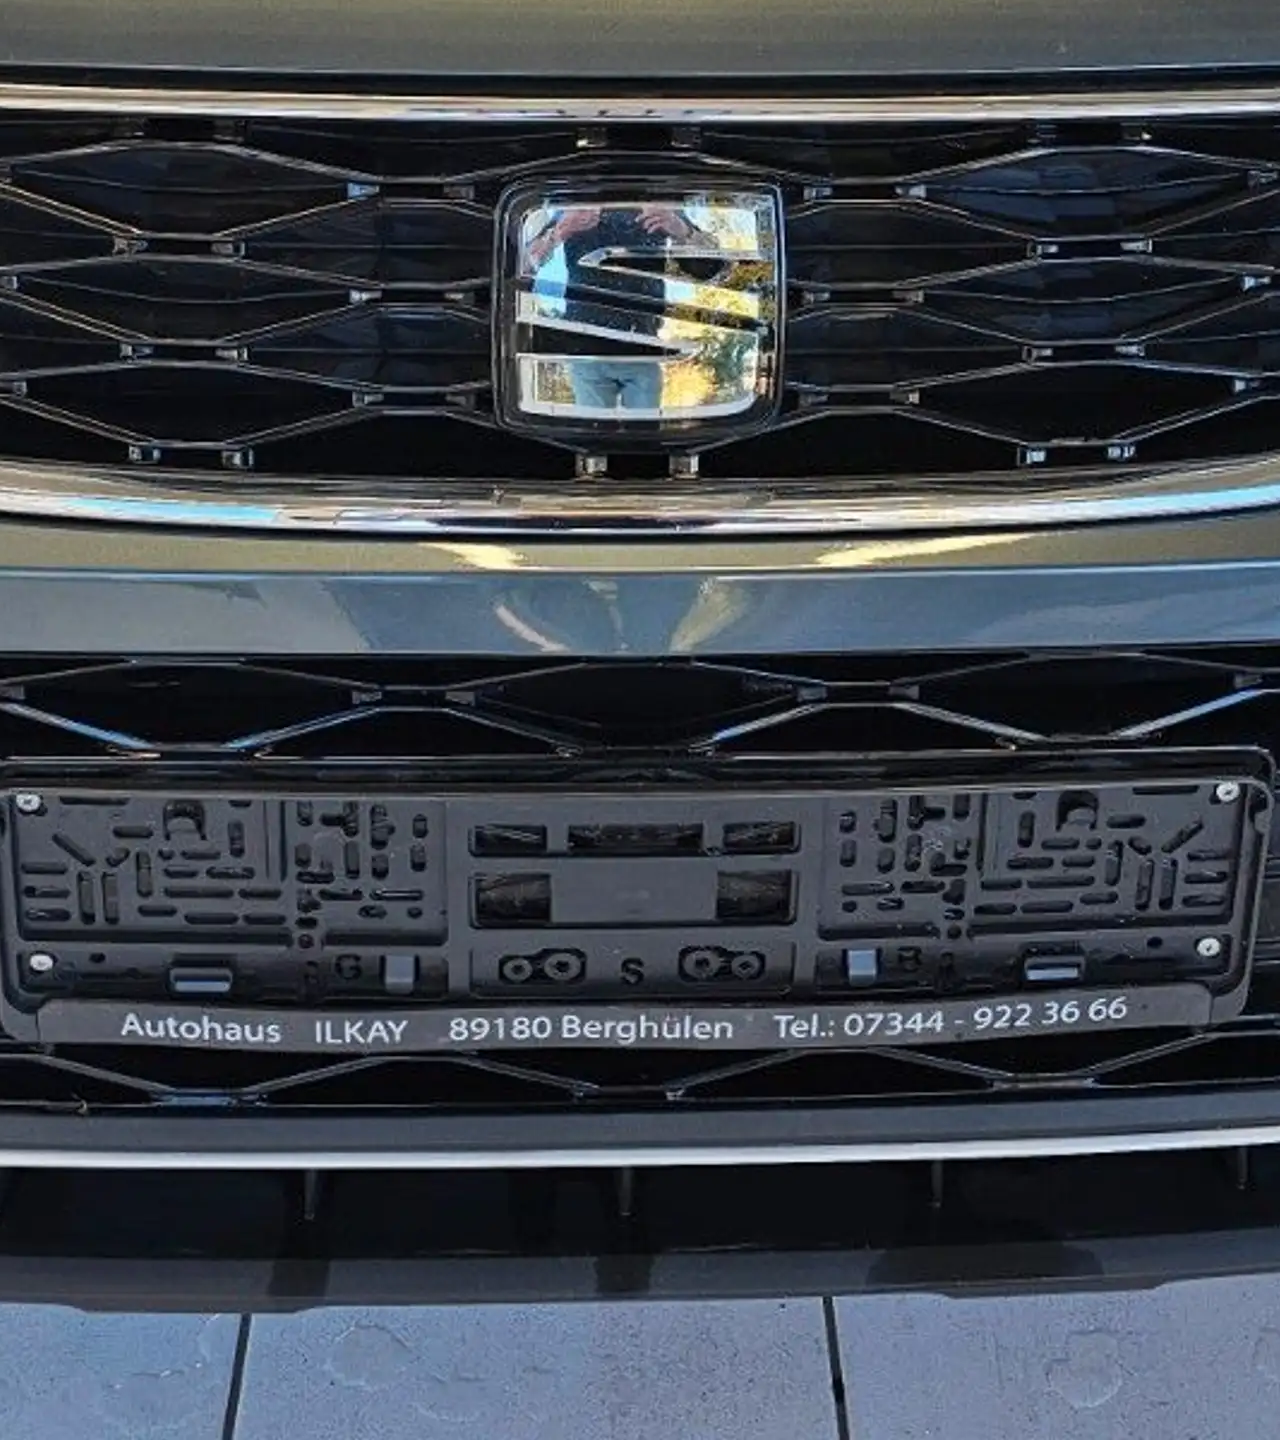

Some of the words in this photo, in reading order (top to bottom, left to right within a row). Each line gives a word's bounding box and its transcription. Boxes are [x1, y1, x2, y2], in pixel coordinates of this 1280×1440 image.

[120, 1012, 282, 1044] Autohaus
[315, 1019, 410, 1045] ILKAY
[449, 1016, 554, 1041] 89180
[561, 1013, 734, 1046] Berghülen
[772, 1012, 835, 1039] Tel.:
[843, 1009, 945, 1036] 07344
[973, 1003, 1033, 1031] 922
[1041, 1000, 1081, 1025] 36
[1087, 996, 1128, 1022] 66
